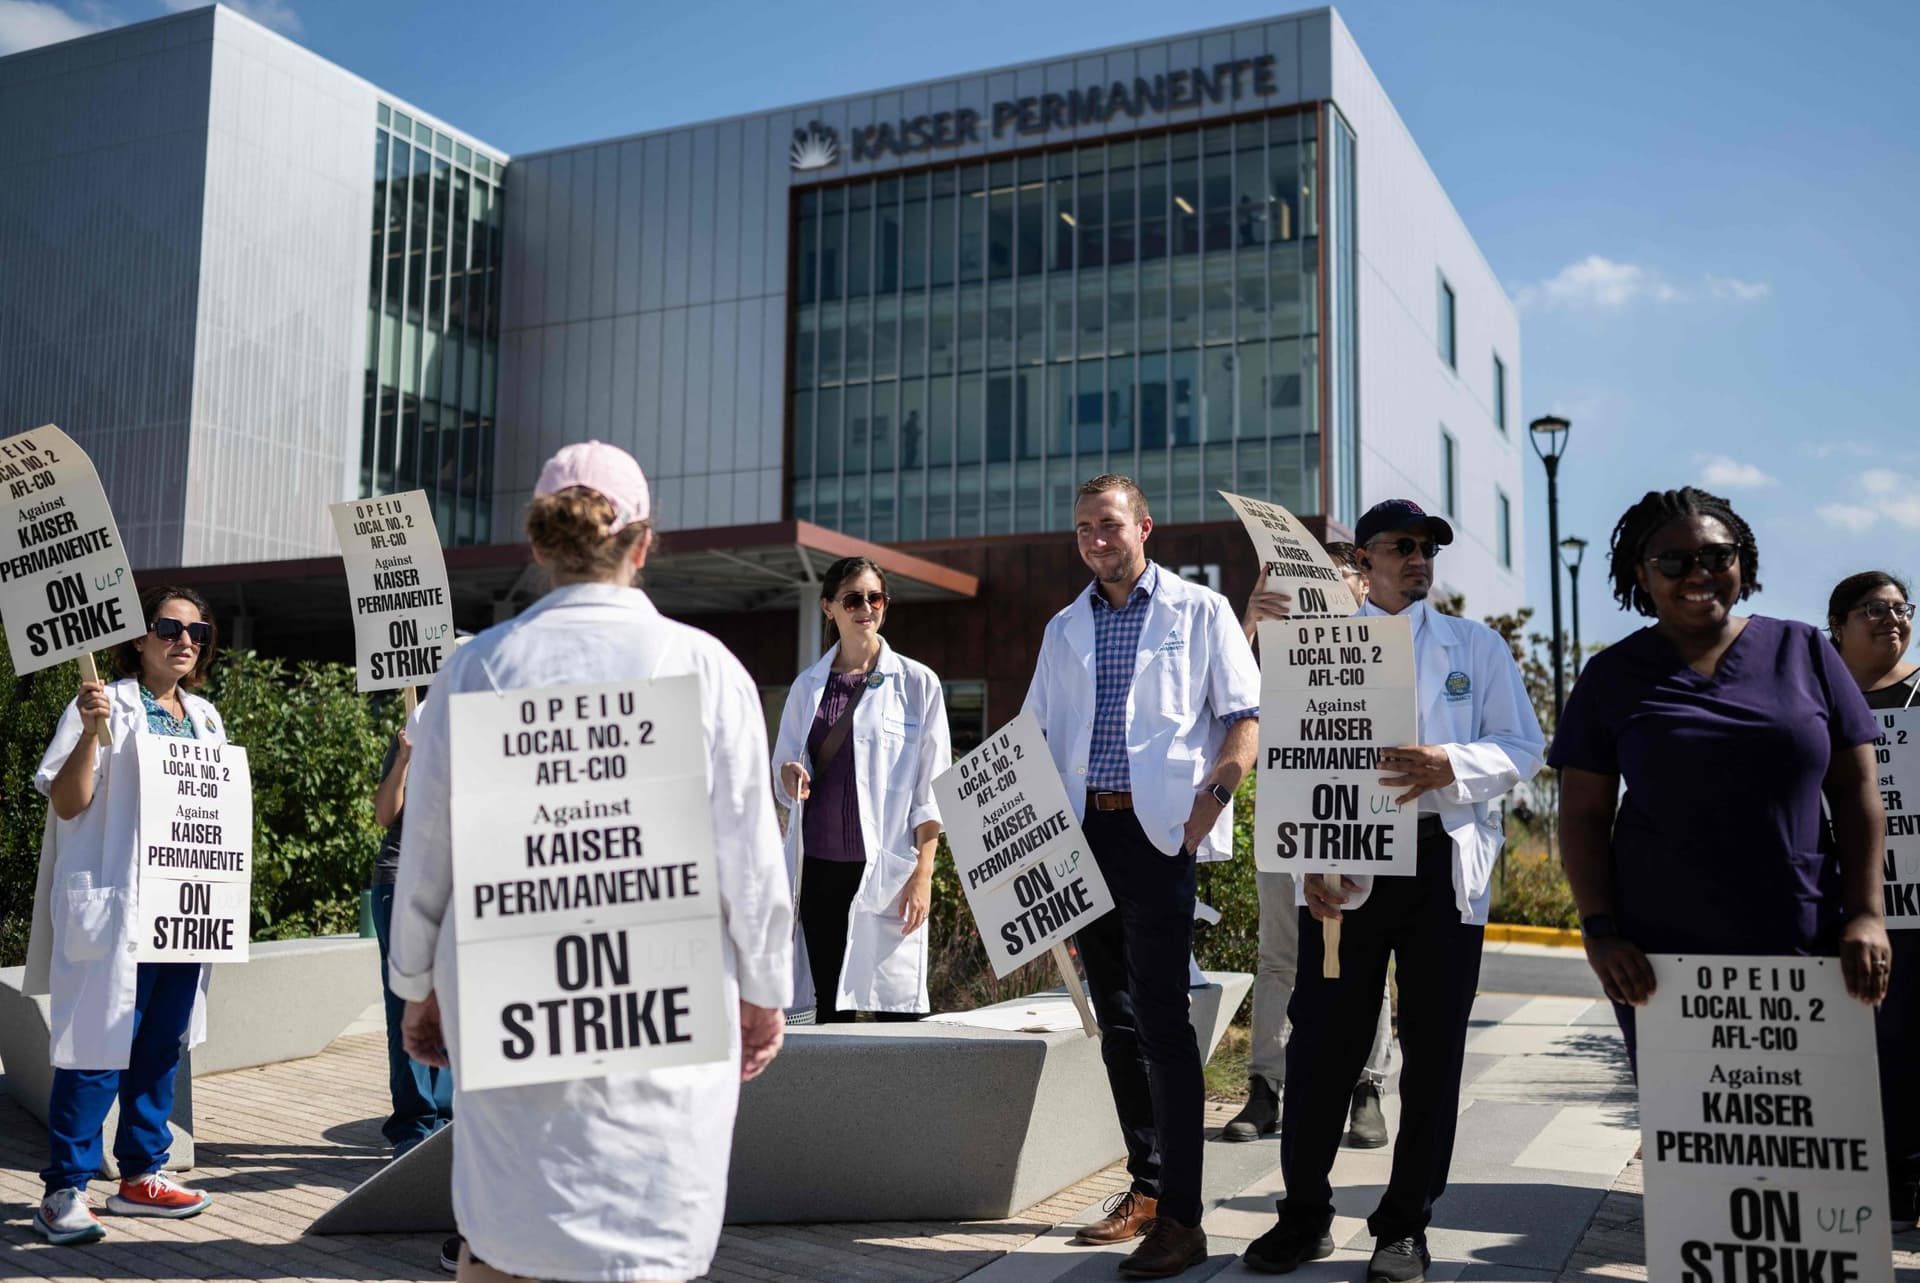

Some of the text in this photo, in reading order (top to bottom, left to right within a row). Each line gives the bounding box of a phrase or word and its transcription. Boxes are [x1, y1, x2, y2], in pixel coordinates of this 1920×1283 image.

[850, 54, 1278, 162] KAISER PERMANENTE
[0, 449, 60, 483] CAL NO. 2
[9, 470, 56, 500] AFL-CIO
[18, 495, 66, 524] Against
[1279, 515, 1290, 525] 2
[17, 511, 79, 549] KAISER
[354, 514, 414, 536] LOCAL NO. 2
[1271, 534, 1300, 545] Against
[1, 527, 112, 583] PERMANENTE
[370, 532, 407, 549] AFL-CIO
[1274, 545, 1313, 563] KAISER
[374, 554, 413, 570] Against
[1267, 561, 1339, 582] PERMANENTE
[46, 572, 89, 614] ON
[94, 567, 124, 591] ULP
[373, 568, 420, 590] KAISER
[357, 587, 443, 615] PERMANENTE
[1298, 587, 1328, 613] ON
[26, 597, 126, 658] STRIKE
[388, 619, 418, 649] ON
[424, 623, 448, 641] ULP
[1289, 646, 1383, 666] LOCAL NO. 2
[1308, 668, 1365, 687] AFL-CIO
[1305, 698, 1367, 715] Against
[503, 720, 655, 757] LOCAL NO. 2
[1300, 717, 1372, 741] KAISER
[1897, 730, 1908, 745] 2
[163, 760, 230, 782] LOCAL NO. 2
[536, 754, 627, 786] AFL-CIO
[958, 744, 1024, 800] LOCAL NO. 2
[1267, 747, 1381, 770] PERMANEN
[177, 780, 218, 799] AFL-CIO
[976, 769, 1017, 808] AFL-CIO
[1312, 783, 1359, 821] ON
[176, 804, 219, 821] Against
[533, 797, 632, 827] Against
[981, 791, 1025, 828] Against
[171, 821, 222, 845] KAISER
[982, 803, 1038, 852] KAISER
[1276, 822, 1394, 861] STRIKE
[148, 846, 244, 871] PERMANENTE
[525, 825, 643, 868] KAISER
[967, 810, 1070, 890] PERMANENTE
[1054, 850, 1080, 878] ULP
[179, 882, 211, 915] ON
[474, 862, 700, 919] PERMANENTE
[1013, 862, 1055, 908] ON
[1000, 877, 1094, 956] STRIKE
[153, 916, 234, 950] STRIKE
[555, 930, 630, 992] ON
[500, 986, 692, 1060] STRIKE
[1681, 995, 1825, 1022] LOCAL NO. 2
[1711, 1025, 1798, 1051] AFL-CIO
[1709, 1064, 1803, 1089] Against
[1702, 1091, 1814, 1128] KAISER
[1656, 1130, 1869, 1172] PERMANENTE
[1729, 1187, 1802, 1243] ON
[1817, 1206, 1872, 1235] ULP
